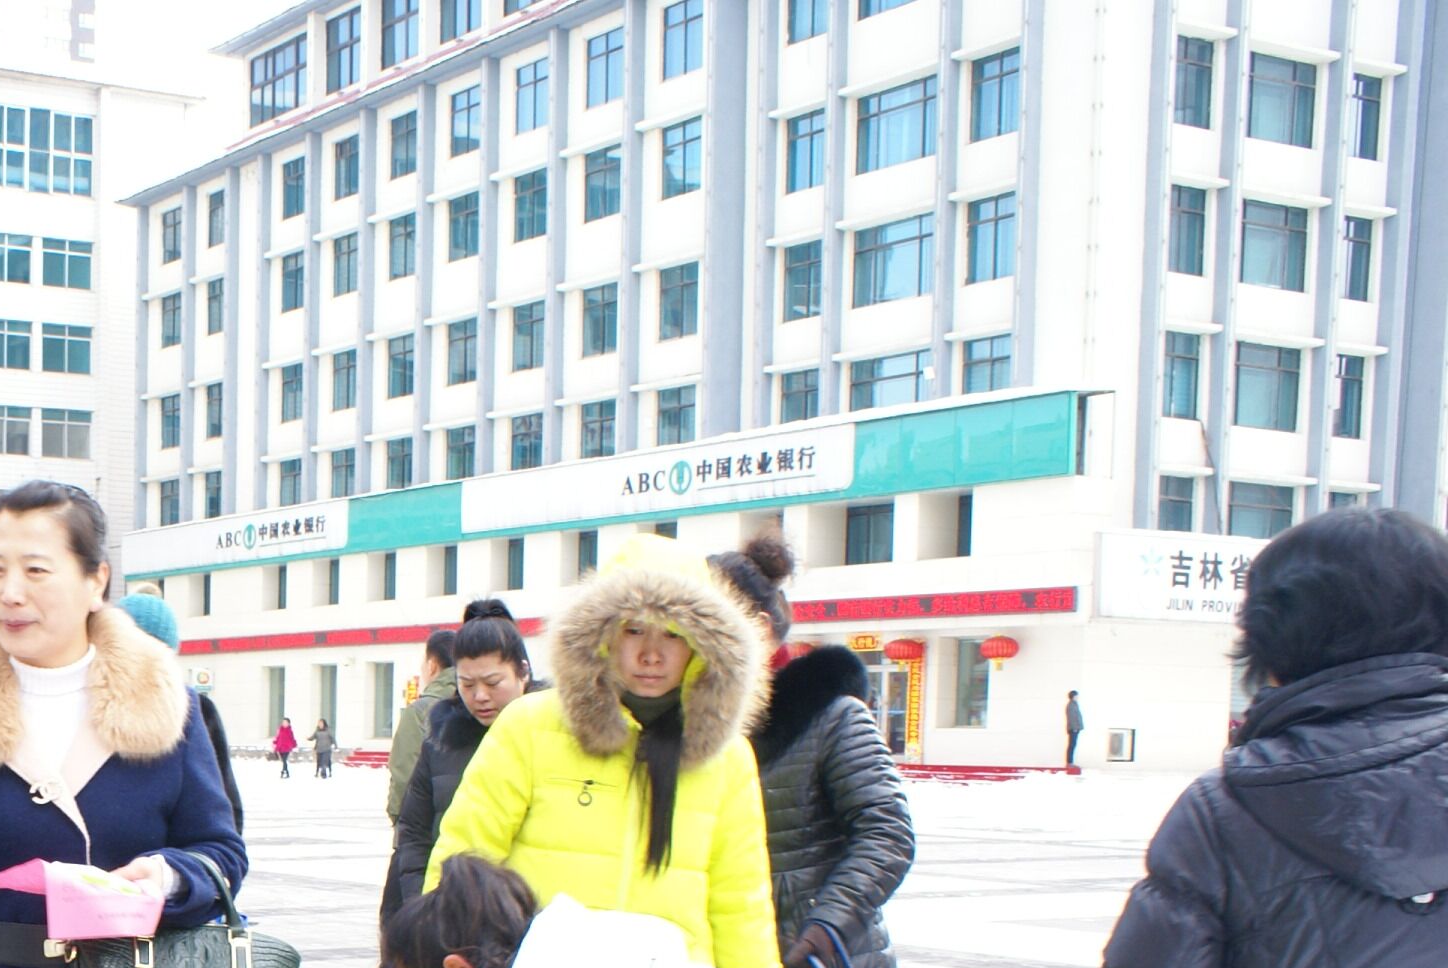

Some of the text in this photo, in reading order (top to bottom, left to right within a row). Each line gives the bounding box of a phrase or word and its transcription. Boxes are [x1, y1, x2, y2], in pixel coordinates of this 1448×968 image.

[696, 446, 817, 483] 中国农业银行
[622, 470, 666, 495] ABC
[216, 530, 242, 549] ABC
[258, 515, 327, 541] 中国农业银行
[1169, 550, 1253, 591] 吉林省
[1166, 598, 1194, 612] JILIN
